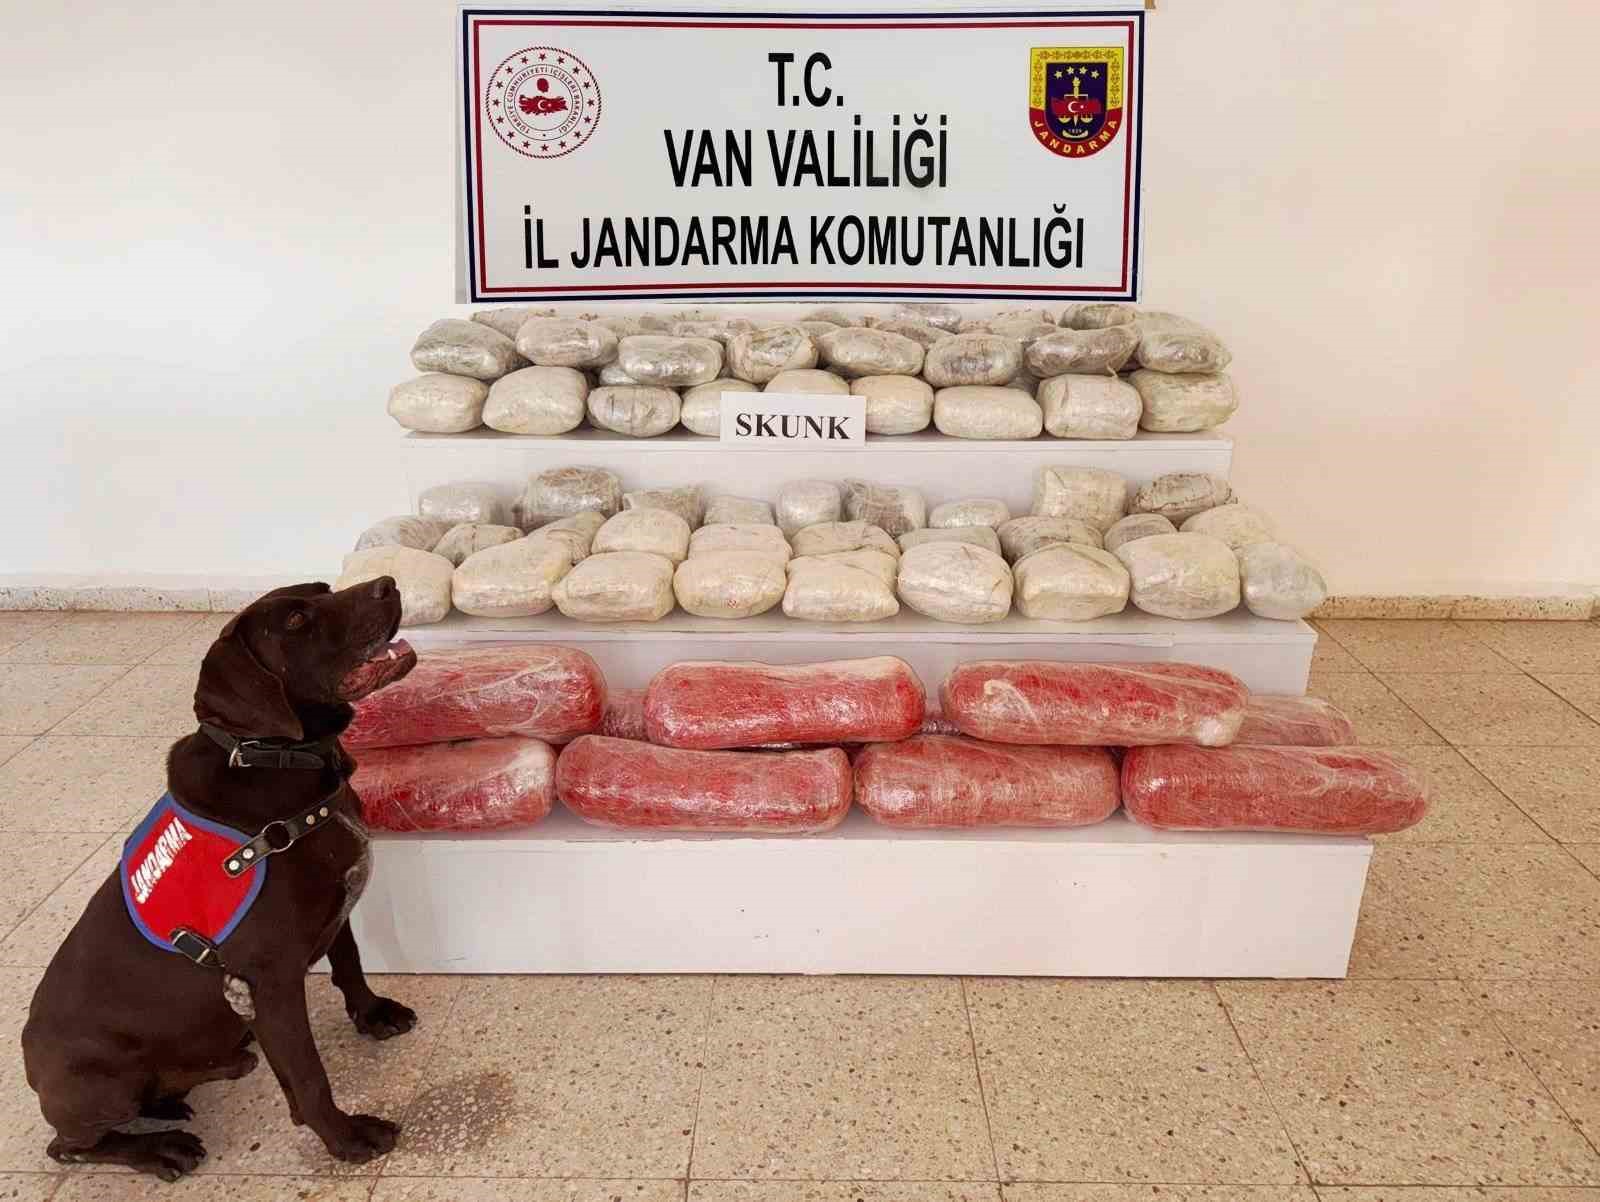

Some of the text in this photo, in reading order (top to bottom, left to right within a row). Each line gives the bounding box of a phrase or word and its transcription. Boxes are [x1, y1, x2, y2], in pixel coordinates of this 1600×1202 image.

[767, 52, 844, 107] T.C.
[663, 113, 947, 189] VAN VALİLİĞİ
[1034, 120, 1117, 154] JANDARMA
[524, 203, 1084, 269] İL JANDARMA KOMUTANLIĞI
[735, 412, 851, 440] SKUNK
[130, 816, 193, 904] JANDARMA
